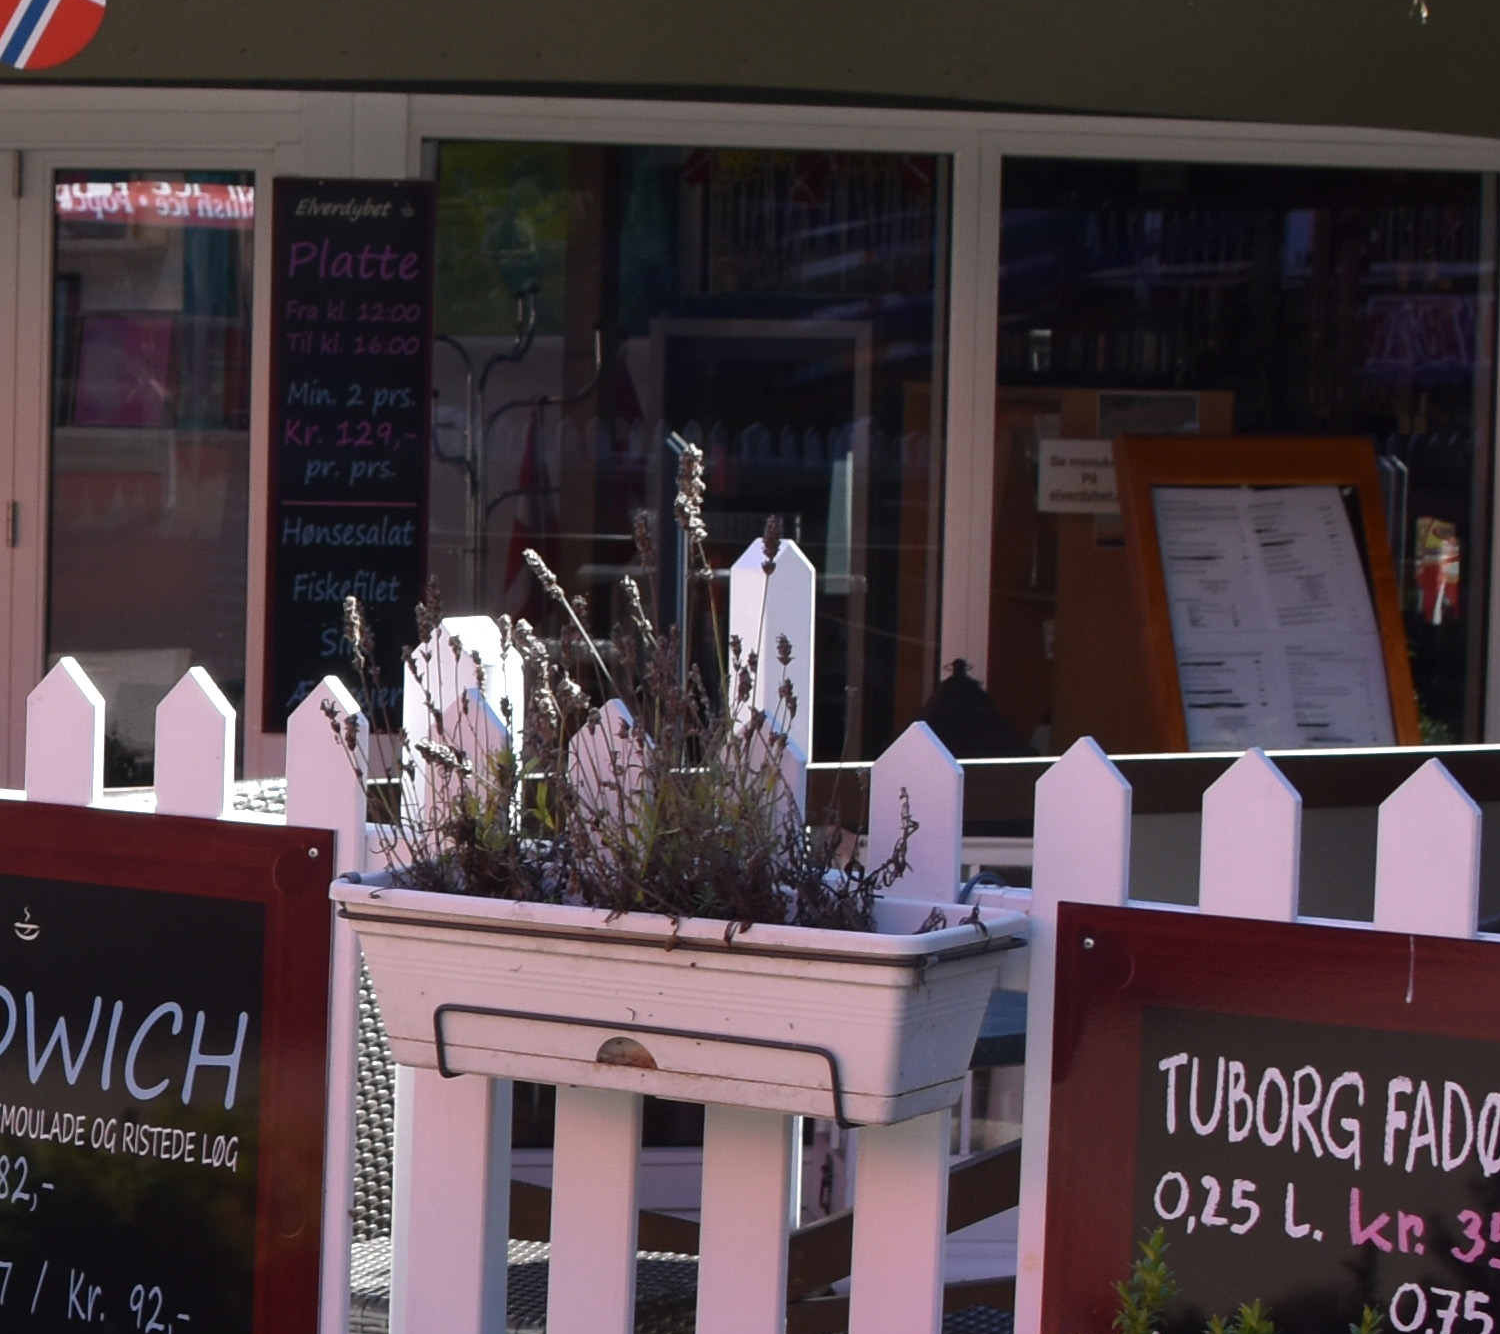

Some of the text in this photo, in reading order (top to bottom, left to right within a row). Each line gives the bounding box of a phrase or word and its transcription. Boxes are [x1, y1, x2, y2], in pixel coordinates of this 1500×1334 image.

[295, 195, 392, 222] Elverdybet
[288, 236, 420, 281] Platte
[285, 299, 319, 322] Fra
[358, 303, 421, 323] 12:00
[286, 331, 313, 354] Til
[354, 335, 421, 356] 16:00
[287, 378, 416, 416] Min. 2 prs.
[284, 418, 418, 453] Kr. 129,-
[304, 458, 396, 486] pr. prs.
[281, 516, 414, 547] Hønsesalat
[292, 570, 400, 603] Fiskefilet
[1158, 1052, 1366, 1170] TUBORG
[90, 1117, 117, 1154] OG
[122, 1122, 196, 1163] RISTEDE
[201, 1133, 239, 1172] LØG
[1153, 1171, 1261, 1236] 0,25
[1349, 1186, 1425, 1255] kr.
[30, 1259, 48, 1314] /
[67, 1268, 105, 1322] Kr.
